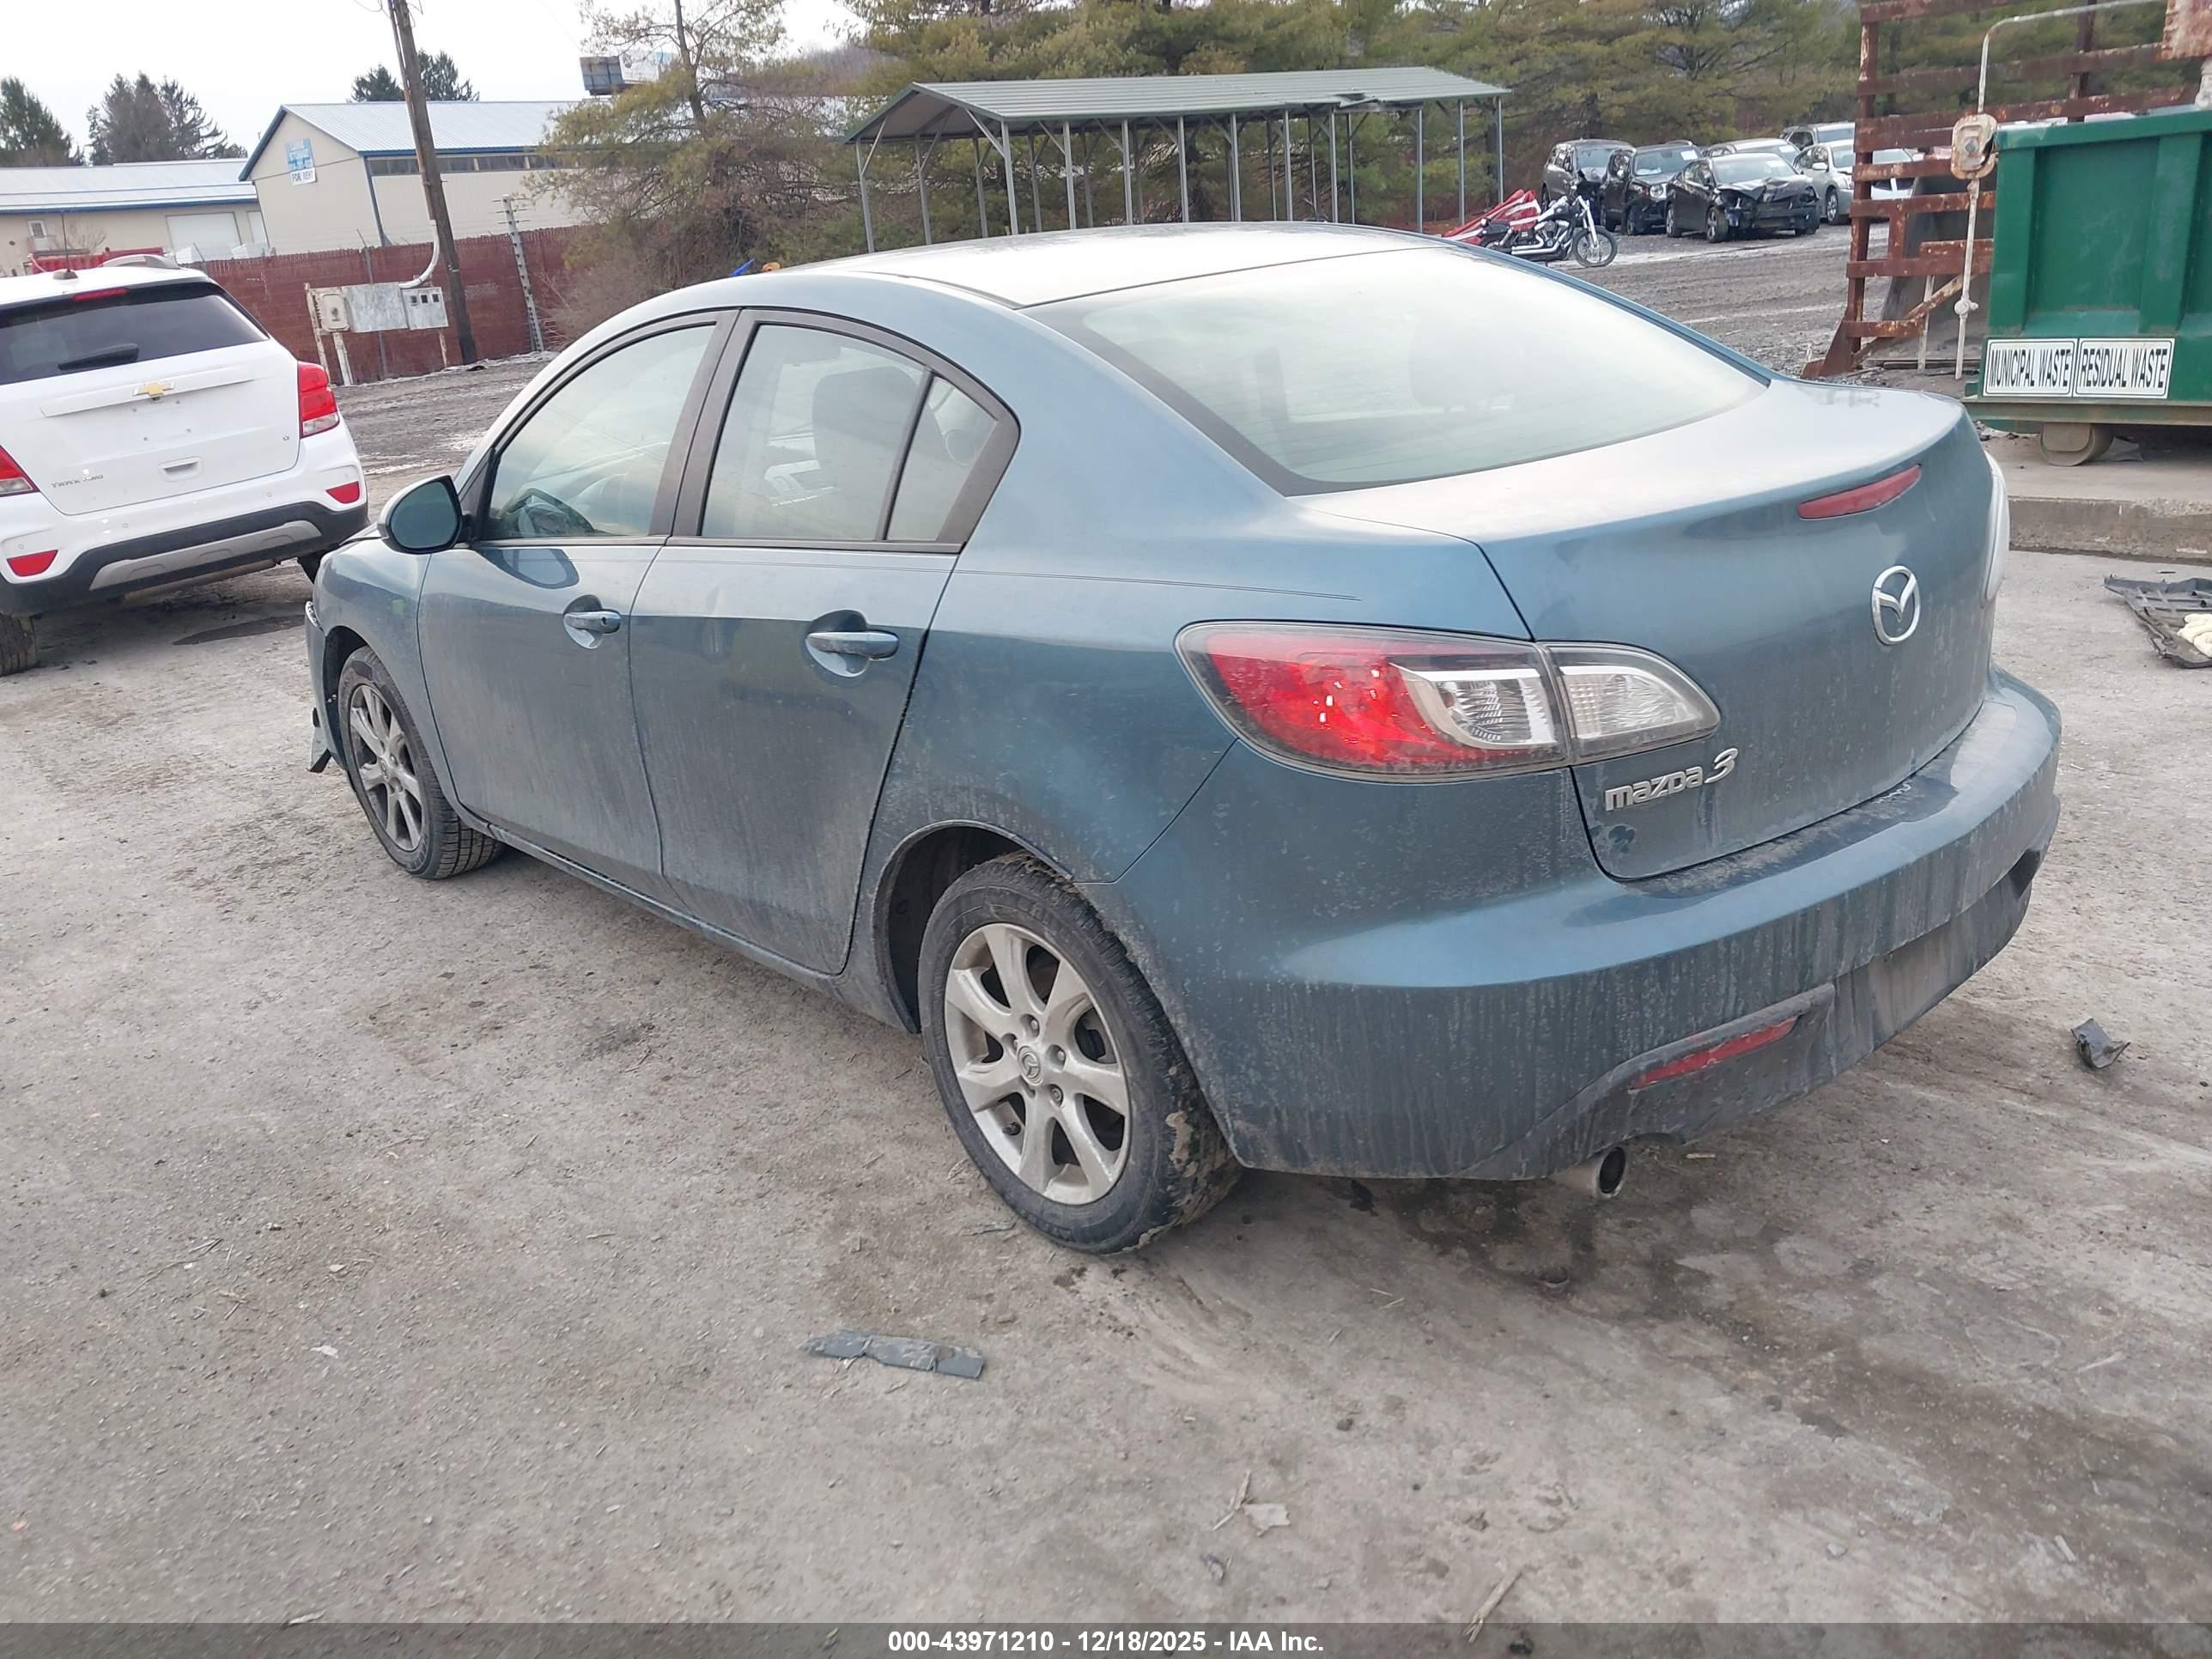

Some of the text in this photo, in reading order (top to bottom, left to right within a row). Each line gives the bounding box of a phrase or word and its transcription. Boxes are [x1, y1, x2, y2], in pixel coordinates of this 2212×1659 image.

[1989, 349, 2071, 387] MUNICIPAL WASTE
[2079, 348, 2168, 389] RESIDUAL WASTE
